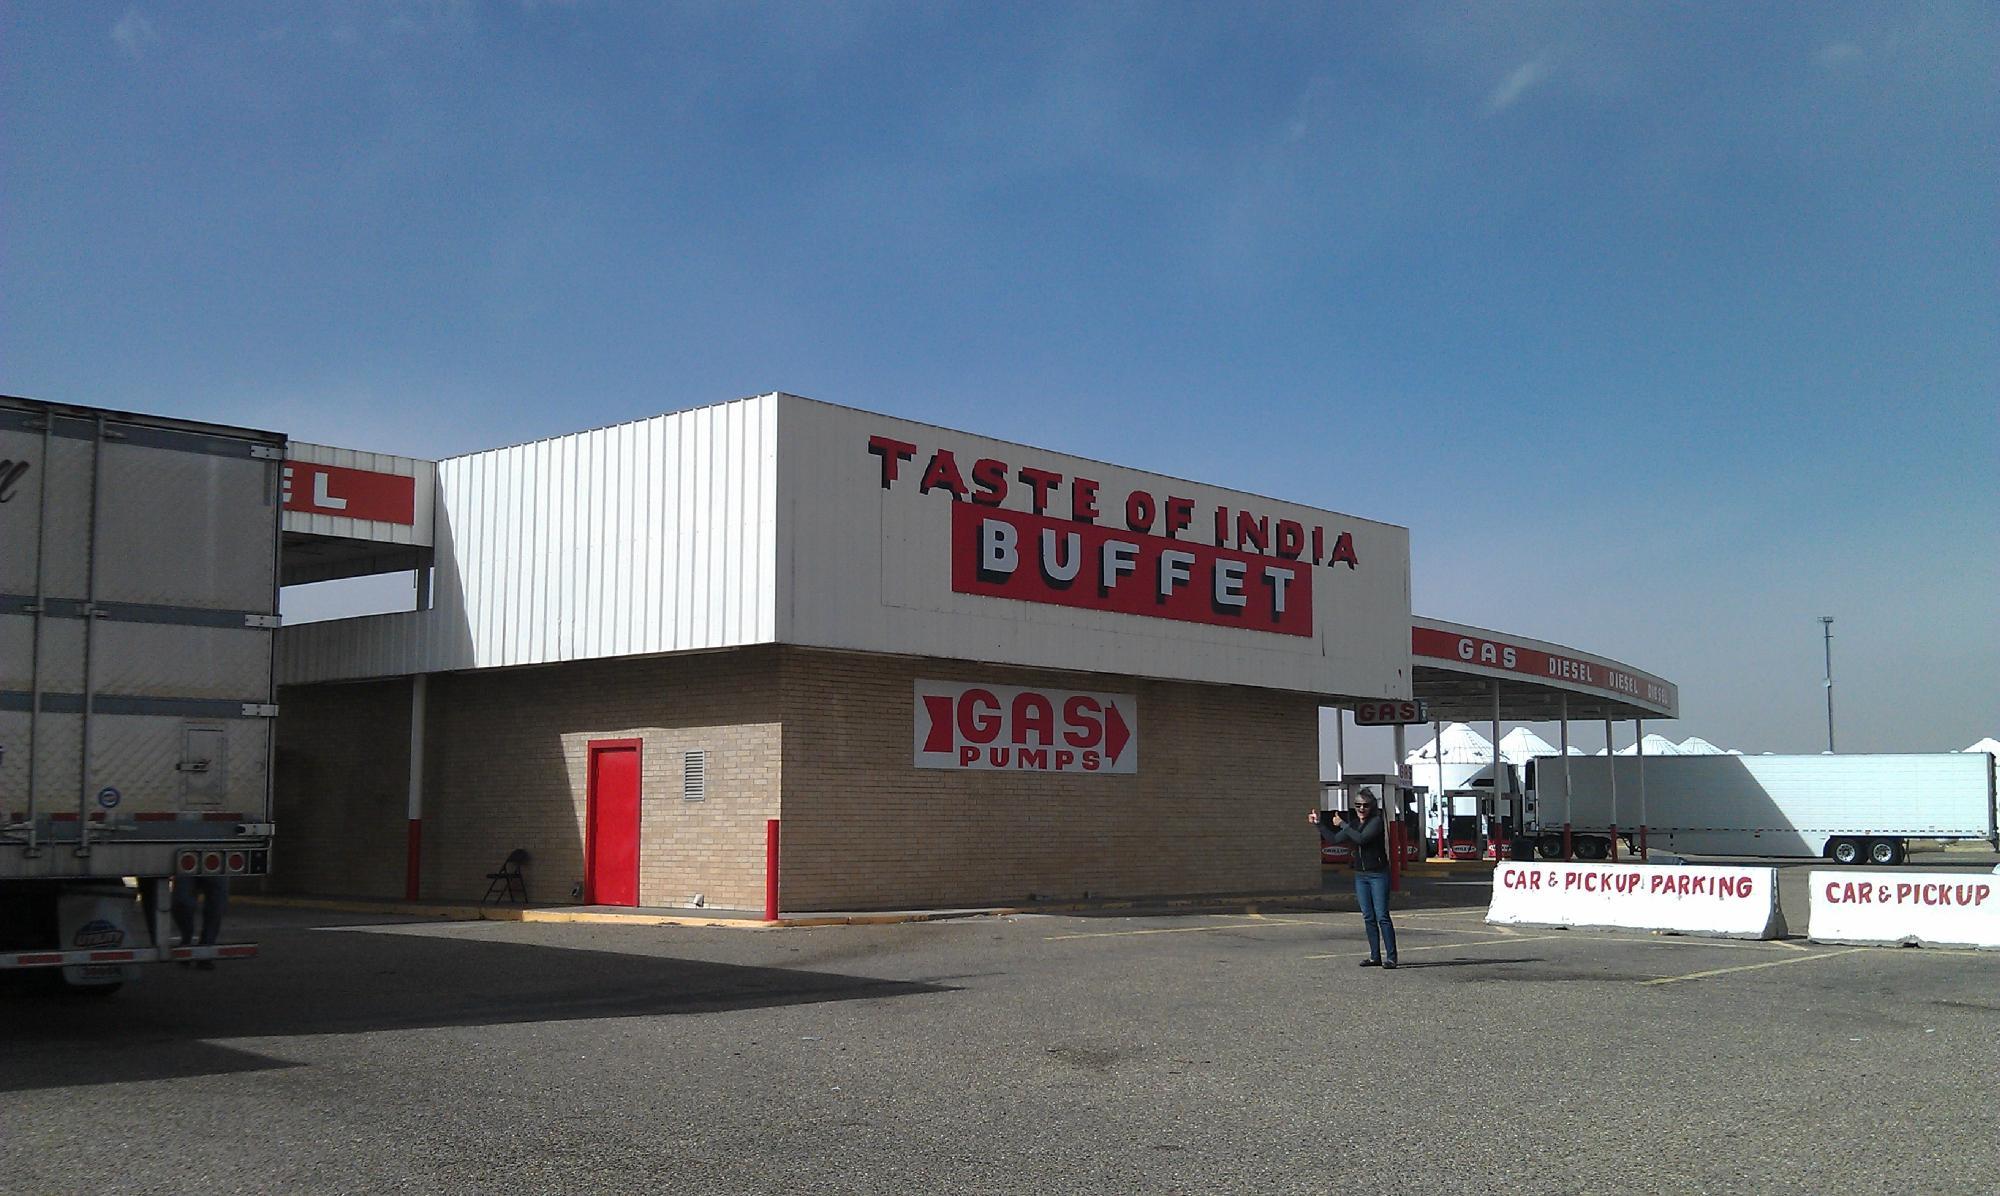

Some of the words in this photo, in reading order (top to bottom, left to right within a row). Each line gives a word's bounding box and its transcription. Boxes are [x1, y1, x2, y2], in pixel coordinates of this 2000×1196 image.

[869, 435, 1100, 521] TASTE
[1126, 490, 1195, 539] OF
[1215, 505, 1359, 568] INDIA
[982, 518, 1295, 613] BUFFET
[1458, 638, 1517, 668] GAS
[1549, 657, 1592, 682] DIESEL
[1609, 671, 1638, 694] DIESEL
[956, 688, 1102, 749] GAS
[1358, 703, 1416, 722] GAS
[960, 745, 1101, 771] PUMPS
[1504, 870, 1541, 890] CAR
[1547, 871, 1558, 887] &
[1565, 872, 1642, 894] PICKUP
[1651, 874, 1753, 898] PARKING
[1825, 882, 1873, 904] CAR
[1878, 885, 1892, 903] &
[1897, 883, 1990, 906] PICKUP
